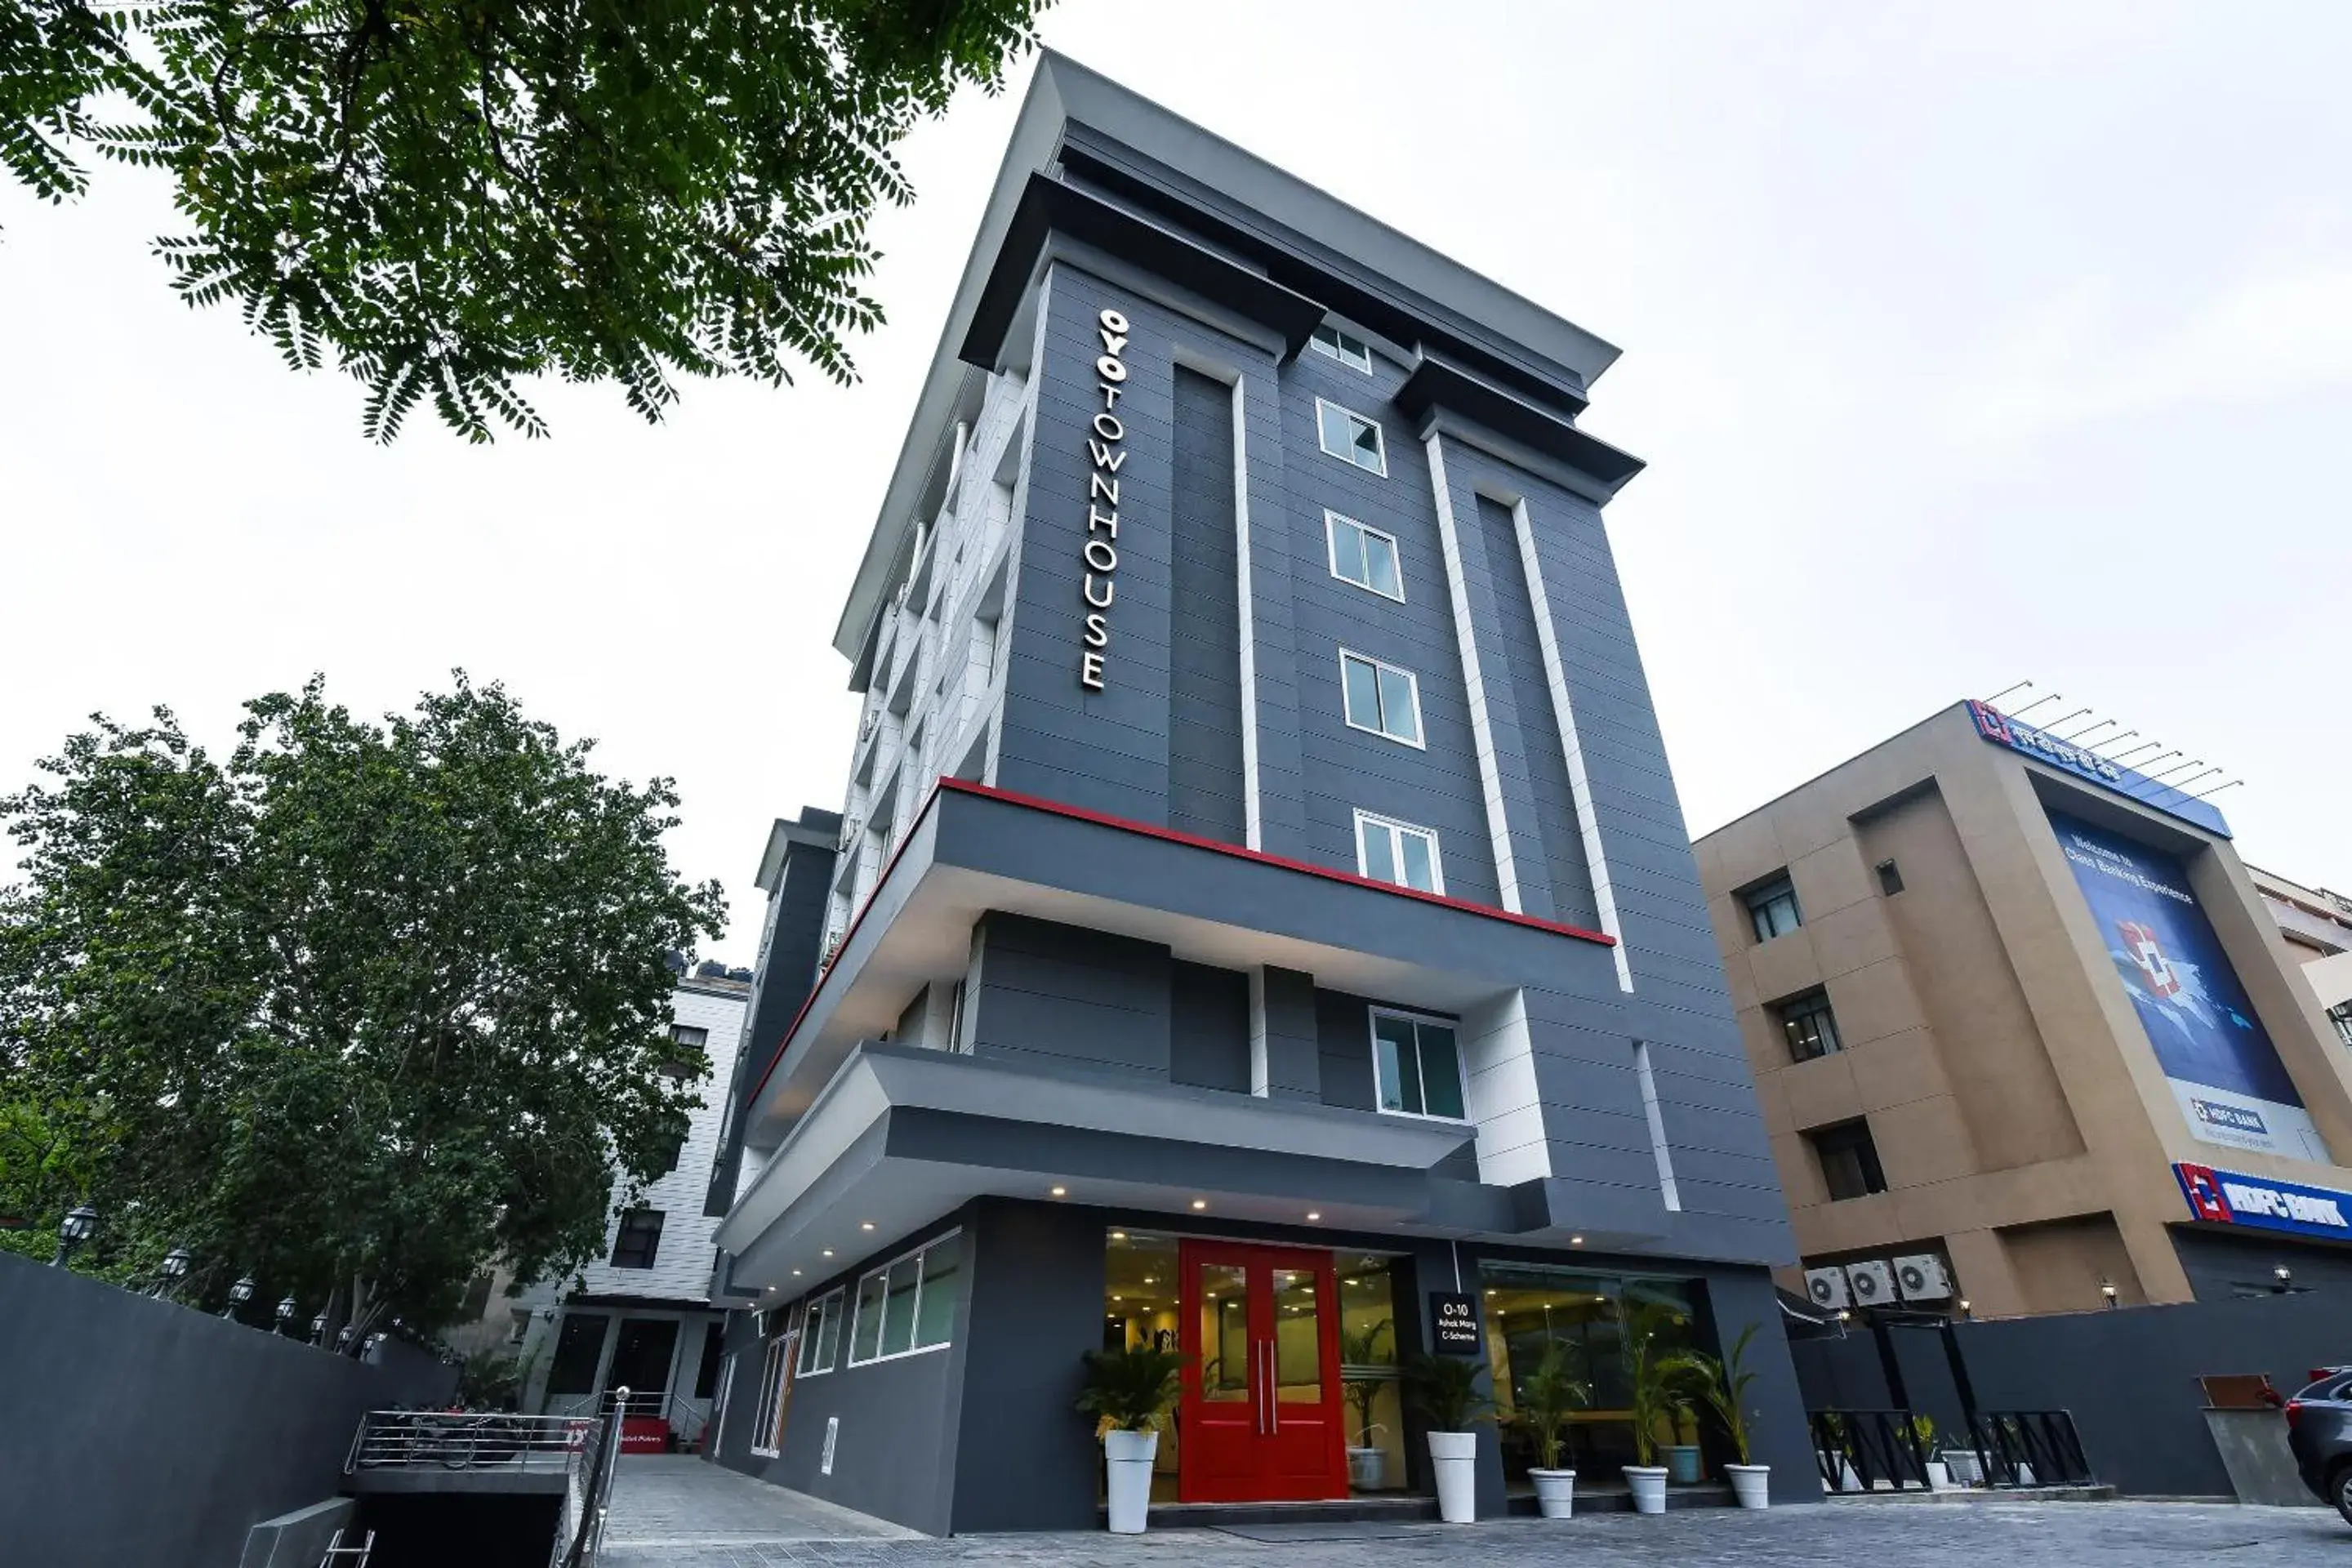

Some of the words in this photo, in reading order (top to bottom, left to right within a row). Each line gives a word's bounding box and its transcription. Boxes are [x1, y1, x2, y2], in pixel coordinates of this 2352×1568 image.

[1097, 309, 1129, 382] OYO
[1082, 382, 1127, 690] TOWNHOUSE
[2070, 833, 2122, 863] Welcome
[2207, 1106, 2235, 1124] HDFC
[2233, 1111, 2262, 1129] BANK
[2221, 1182, 2289, 1218] HDFC
[2283, 1192, 2350, 1227] BANK
[1444, 1303, 1468, 1316] O-10
[1439, 1319, 1459, 1327] Ashok
[1459, 1320, 1476, 1330] Marg
[1442, 1331, 1475, 1341] C-Scheme
